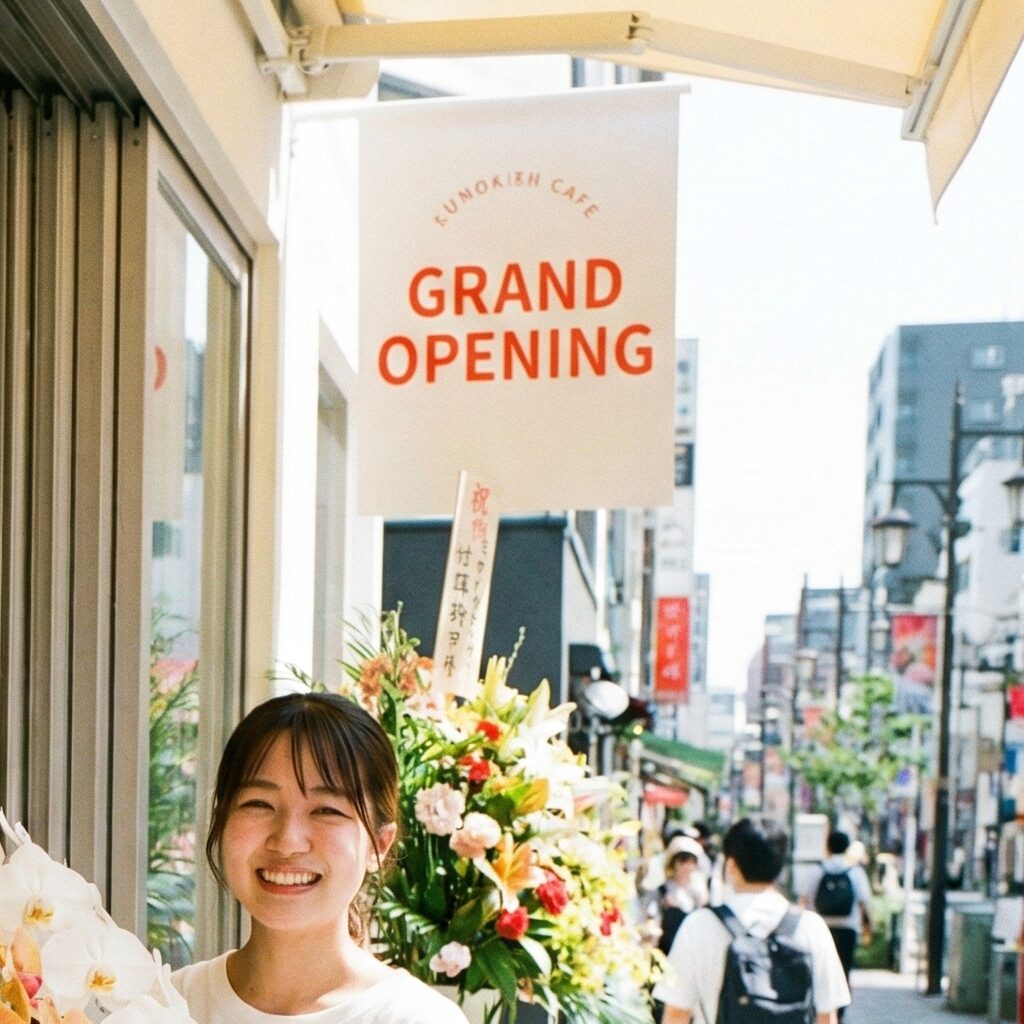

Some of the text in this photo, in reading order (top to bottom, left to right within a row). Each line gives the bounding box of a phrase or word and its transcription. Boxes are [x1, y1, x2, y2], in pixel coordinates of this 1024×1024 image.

[550, 178, 599, 218] CAFE
[408, 257, 623, 318] GRAND
[378, 323, 653, 386] OPENING
